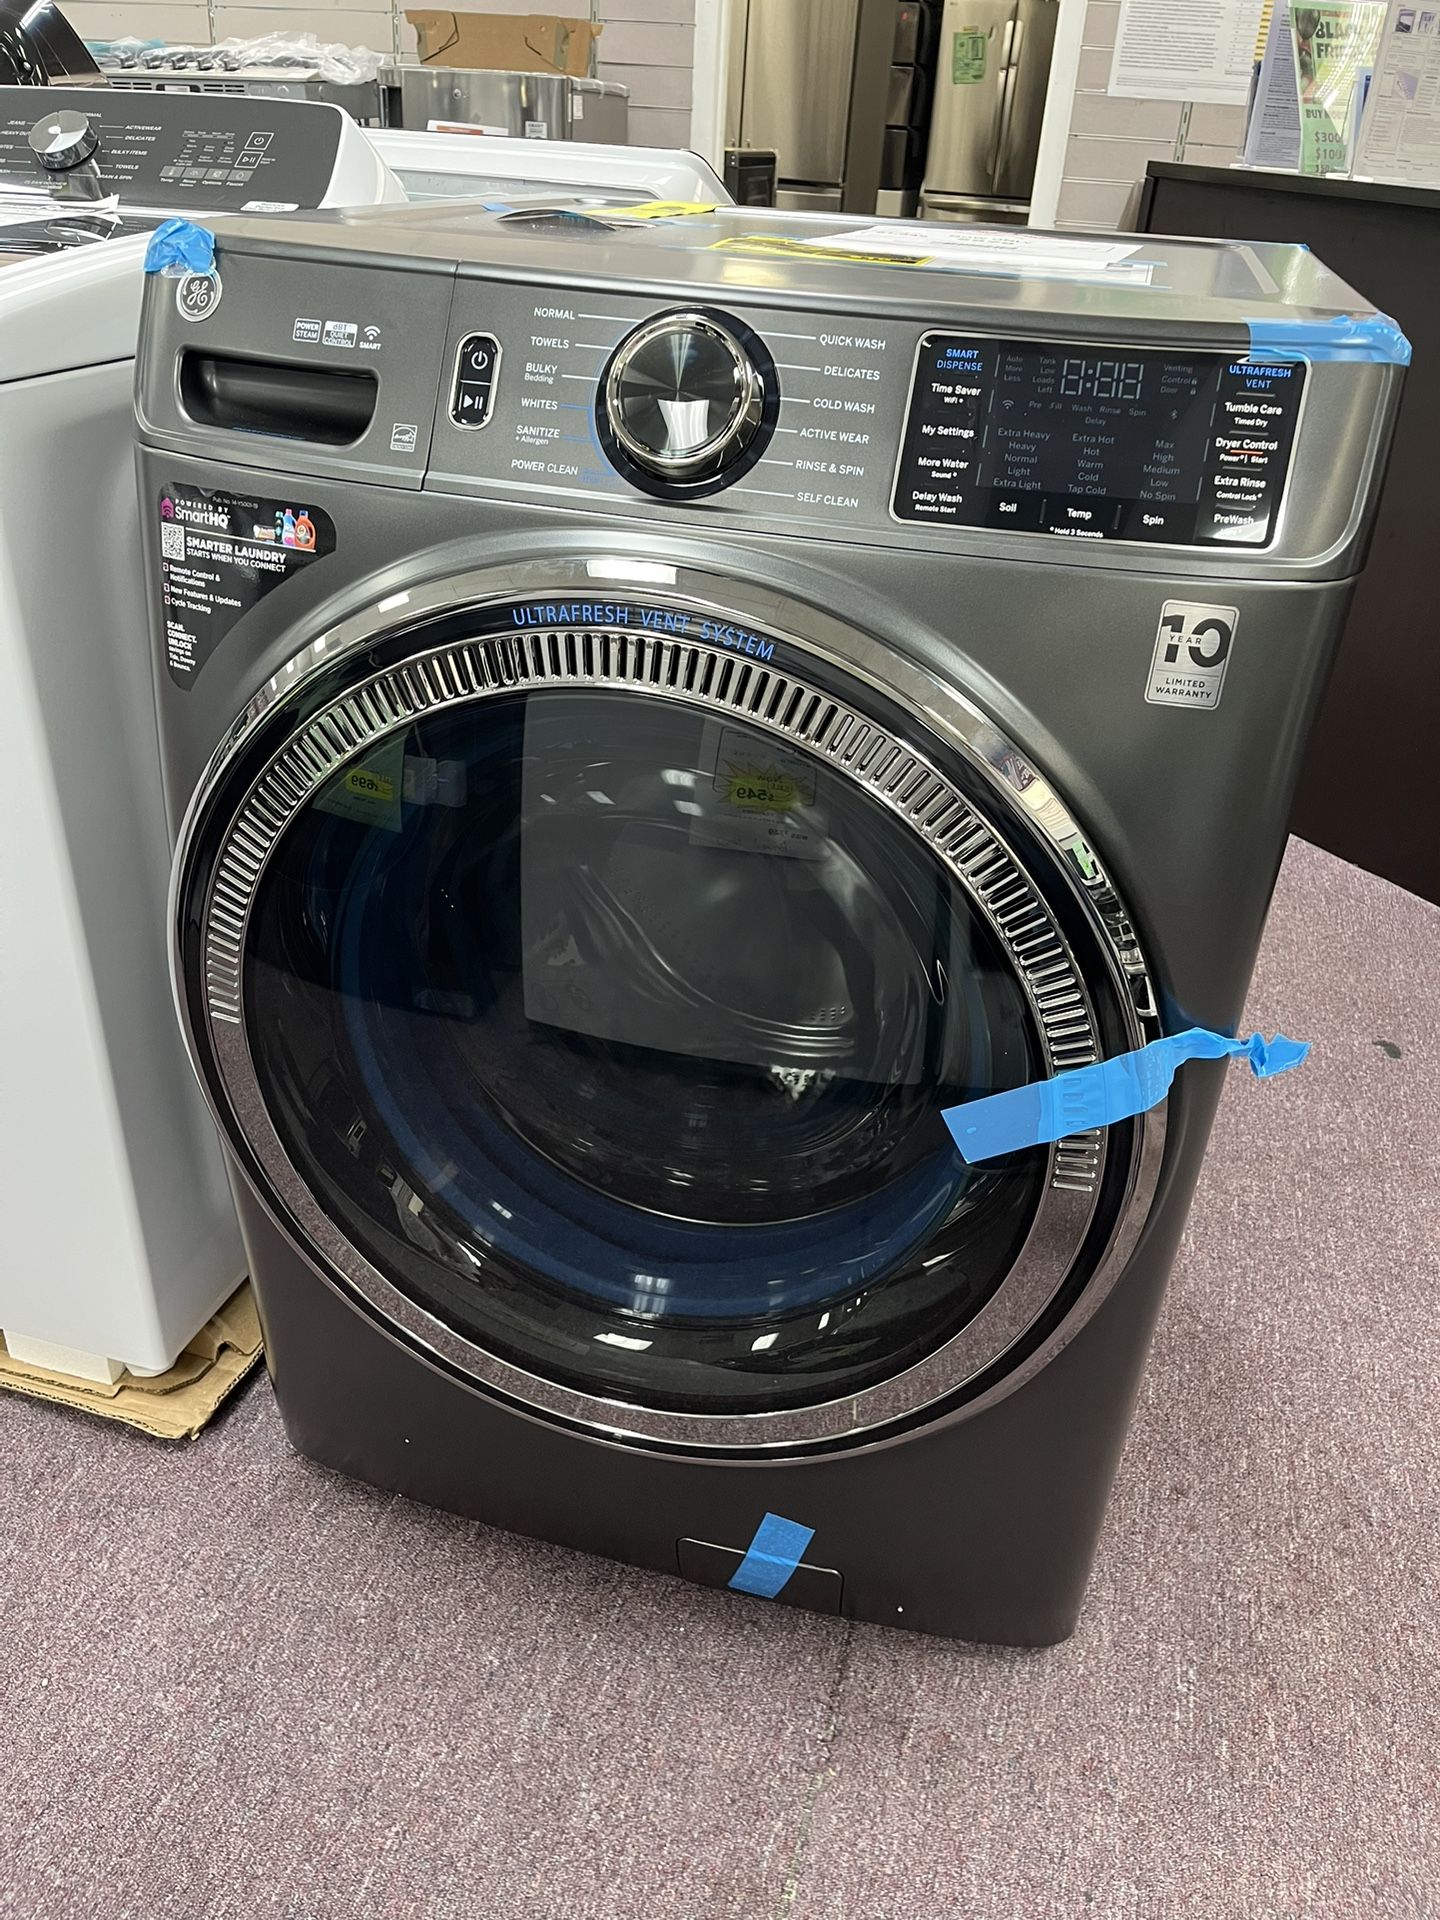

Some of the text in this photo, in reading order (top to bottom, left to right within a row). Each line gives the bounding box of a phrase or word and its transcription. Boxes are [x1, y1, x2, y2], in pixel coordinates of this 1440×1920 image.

[1306, 109, 1322, 119] BUY
[1315, 131, 1342, 143] $300
[533, 307, 576, 320] NORMAL
[296, 321, 320, 331] POWER
[295, 330, 318, 339] STEAM
[359, 341, 382, 351] SMART
[530, 336, 570, 349] TOWELS
[819, 334, 887, 351] QUICK WASH
[945, 348, 980, 359] SMART
[936, 360, 984, 372] DISPENSE
[1006, 356, 1024, 364] Auto
[1039, 356, 1057, 365] Tank
[525, 362, 558, 374] BULKY
[824, 365, 881, 381] DELICATES
[1005, 364, 1023, 373] More
[1040, 366, 1056, 375] Low
[1163, 364, 1193, 375] Venting
[1229, 364, 1292, 378] ULTRAFRESH
[524, 373, 554, 385] Bedding
[1004, 374, 1022, 383] Less
[1032, 376, 1055, 385] Loads
[1161, 375, 1191, 385] Control
[1245, 378, 1272, 389] VENT
[931, 382, 982, 397] Time Saver
[1037, 385, 1053, 394] Left
[1160, 386, 1178, 394] Door
[521, 397, 558, 410] WHITES
[813, 398, 876, 414] COLD WASH
[1028, 401, 1147, 418] Pre Fill Wash Rinse Spin
[1224, 401, 1283, 416] Tumble Care
[1084, 416, 1107, 427] Delay
[1233, 417, 1269, 428] Timed Dry
[516, 425, 561, 439] SANITIZE
[799, 427, 870, 445] ACTIVE WEAR
[921, 424, 975, 439] My Settings
[998, 428, 1051, 441] Extra Heavy
[520, 435, 549, 446] Allergen
[1072, 433, 1115, 445] Extra Hot
[1154, 439, 1175, 449] Max
[1215, 437, 1279, 451] Dryer Control
[1008, 441, 1037, 452] Heavy
[1083, 447, 1100, 457] Hot
[917, 456, 970, 469] More Water
[1004, 453, 1038, 464] Normal
[1152, 452, 1175, 463] High
[1219, 453, 1269, 464] Power Start
[511, 459, 579, 476] POWER CLEAN
[795, 459, 865, 477] RINSE & SPIN
[1077, 459, 1104, 470] Warm
[1142, 464, 1181, 476] Medium
[931, 470, 952, 480] Sound
[1007, 466, 1031, 477] Light
[1077, 472, 1099, 482] Cold
[993, 477, 1042, 491] Extra Light
[1150, 478, 1170, 488] Low
[1213, 475, 1267, 489] Extra Rinse
[1067, 484, 1107, 496] Tap Cold
[1139, 490, 1177, 502] No Spin
[1215, 490, 1258, 502] Control Lock
[796, 492, 859, 508] SELF CLEAN
[912, 490, 964, 504] Delay Wash
[175, 498, 214, 511] POWERED
[217, 505, 229, 514] BY
[914, 503, 957, 514] Remote Start
[998, 502, 1018, 513] Soil
[1066, 507, 1093, 521] Temp
[1142, 514, 1165, 526] Spin
[1213, 513, 1255, 526] PreWash
[1054, 527, 1104, 539] Hold 3 Seconds
[185, 536, 287, 564] SMARTER LAUNDRY
[186, 547, 287, 574] STARTS WHEN YOU CONNECT
[169, 563, 221, 582] Remote Control &
[169, 573, 206, 588] Notifications
[170, 584, 242, 608] New Features & Updates
[170, 597, 212, 615] Cycle Tracking
[512, 604, 776, 661] ULTRAFRESH VENT SYSTEM
[167, 636, 193, 651] UNLOCK
[1161, 614, 1232, 669] 10
[1169, 635, 1202, 645] YEAR
[1165, 677, 1206, 689] LIMITED
[1155, 686, 1213, 699] WARRANTY
